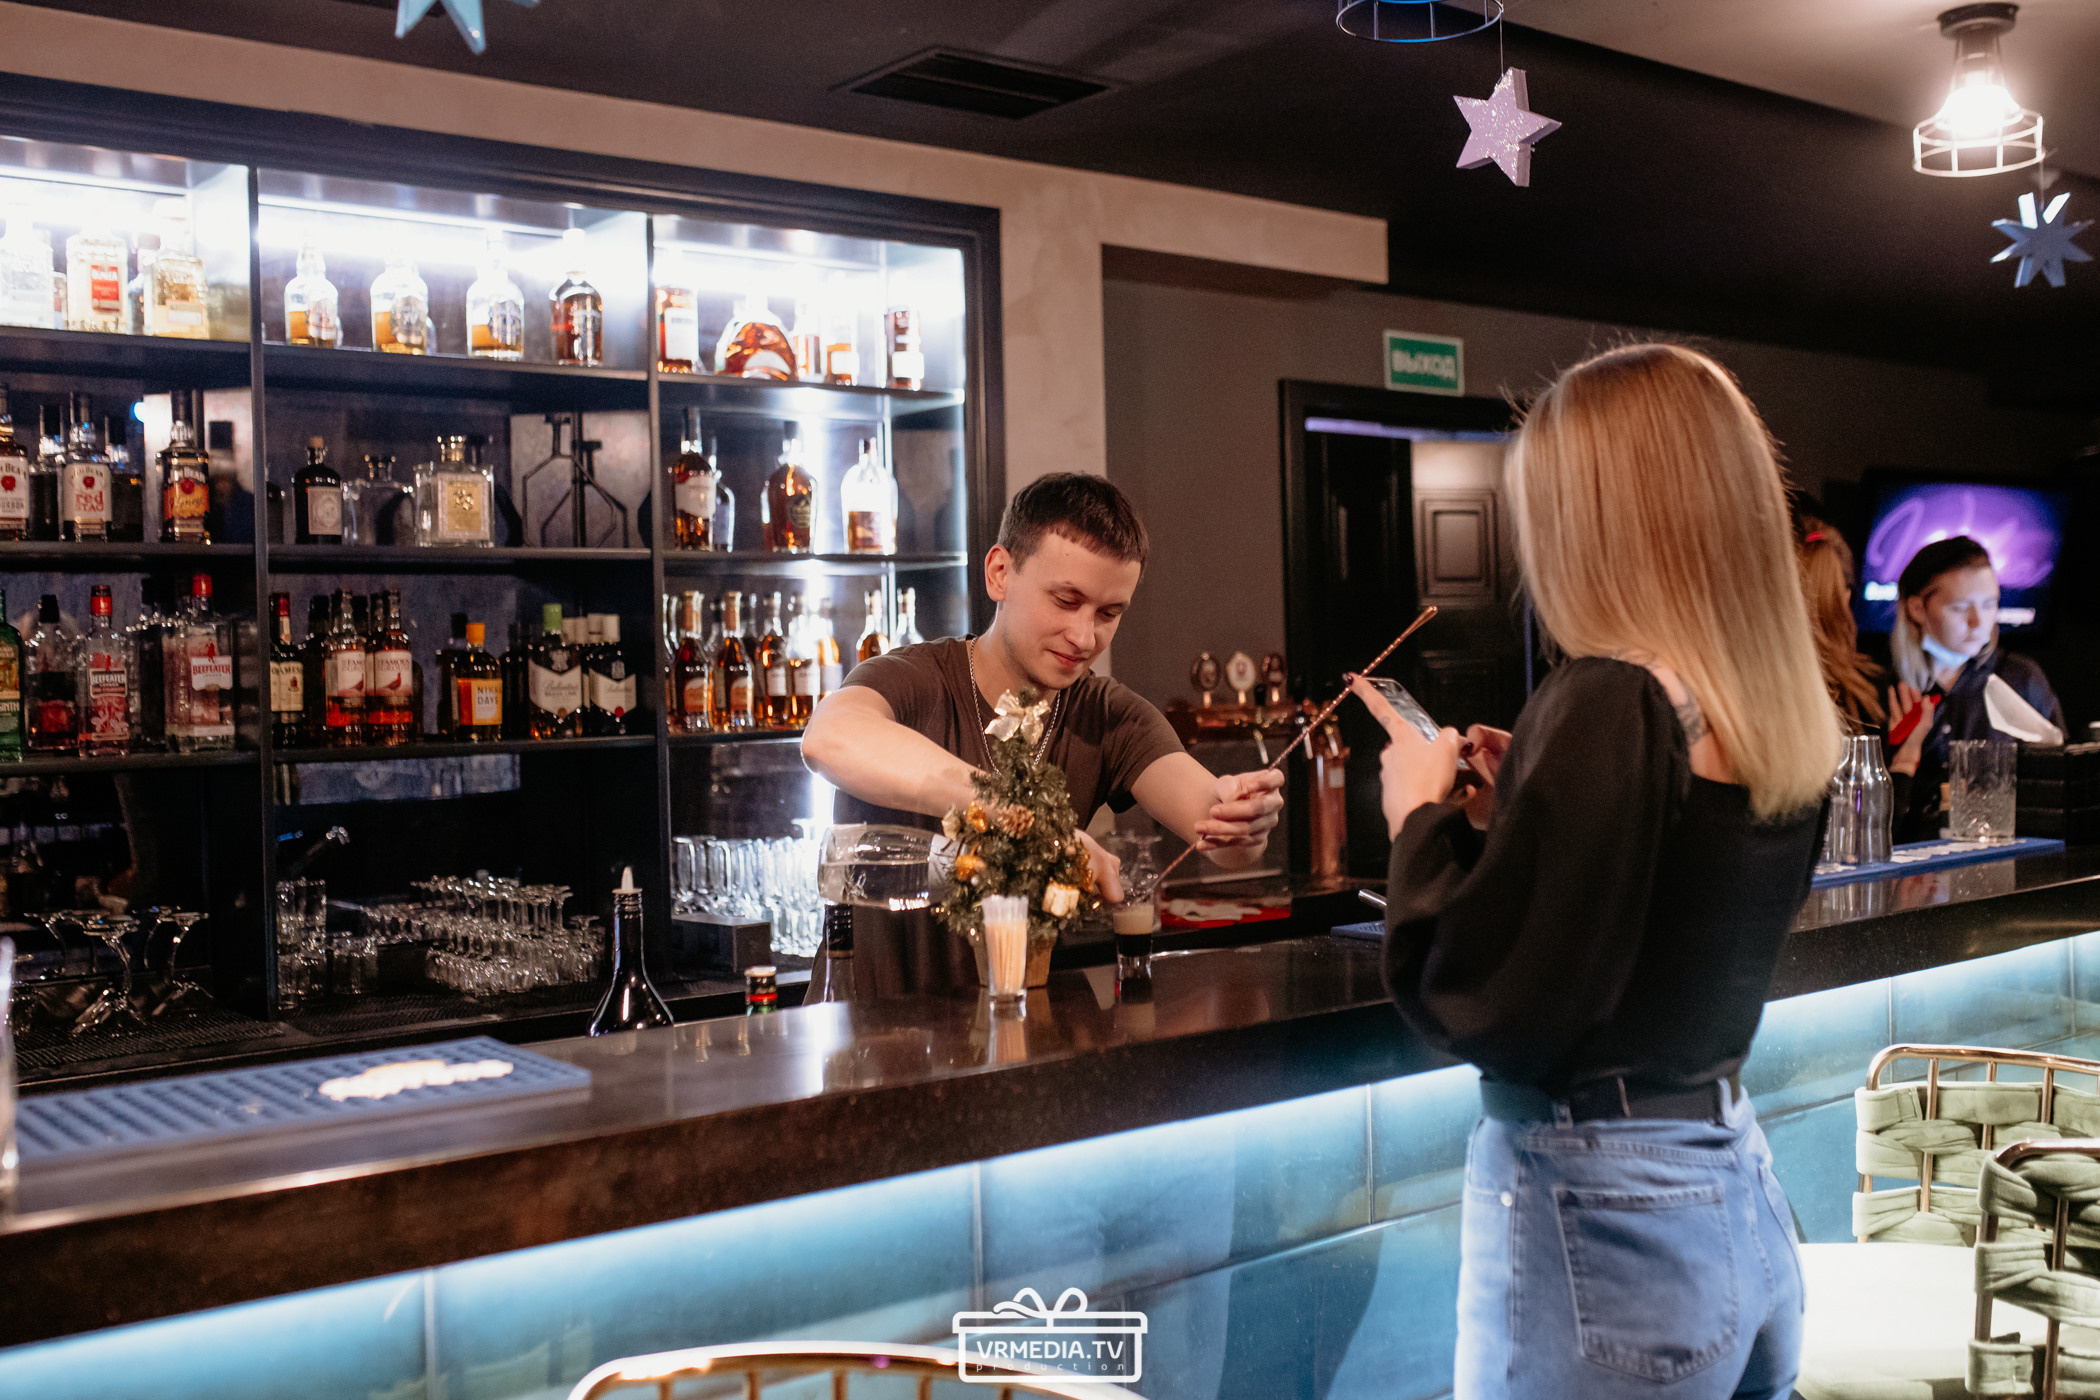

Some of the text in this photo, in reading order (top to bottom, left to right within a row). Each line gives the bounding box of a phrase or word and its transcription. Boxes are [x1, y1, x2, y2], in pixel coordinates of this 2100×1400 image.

[1392, 349, 1456, 380] ВЫХОД
[75, 491, 104, 504] red
[193, 664, 231, 675] BEEFEATER
[477, 696, 499, 705] DAYS
